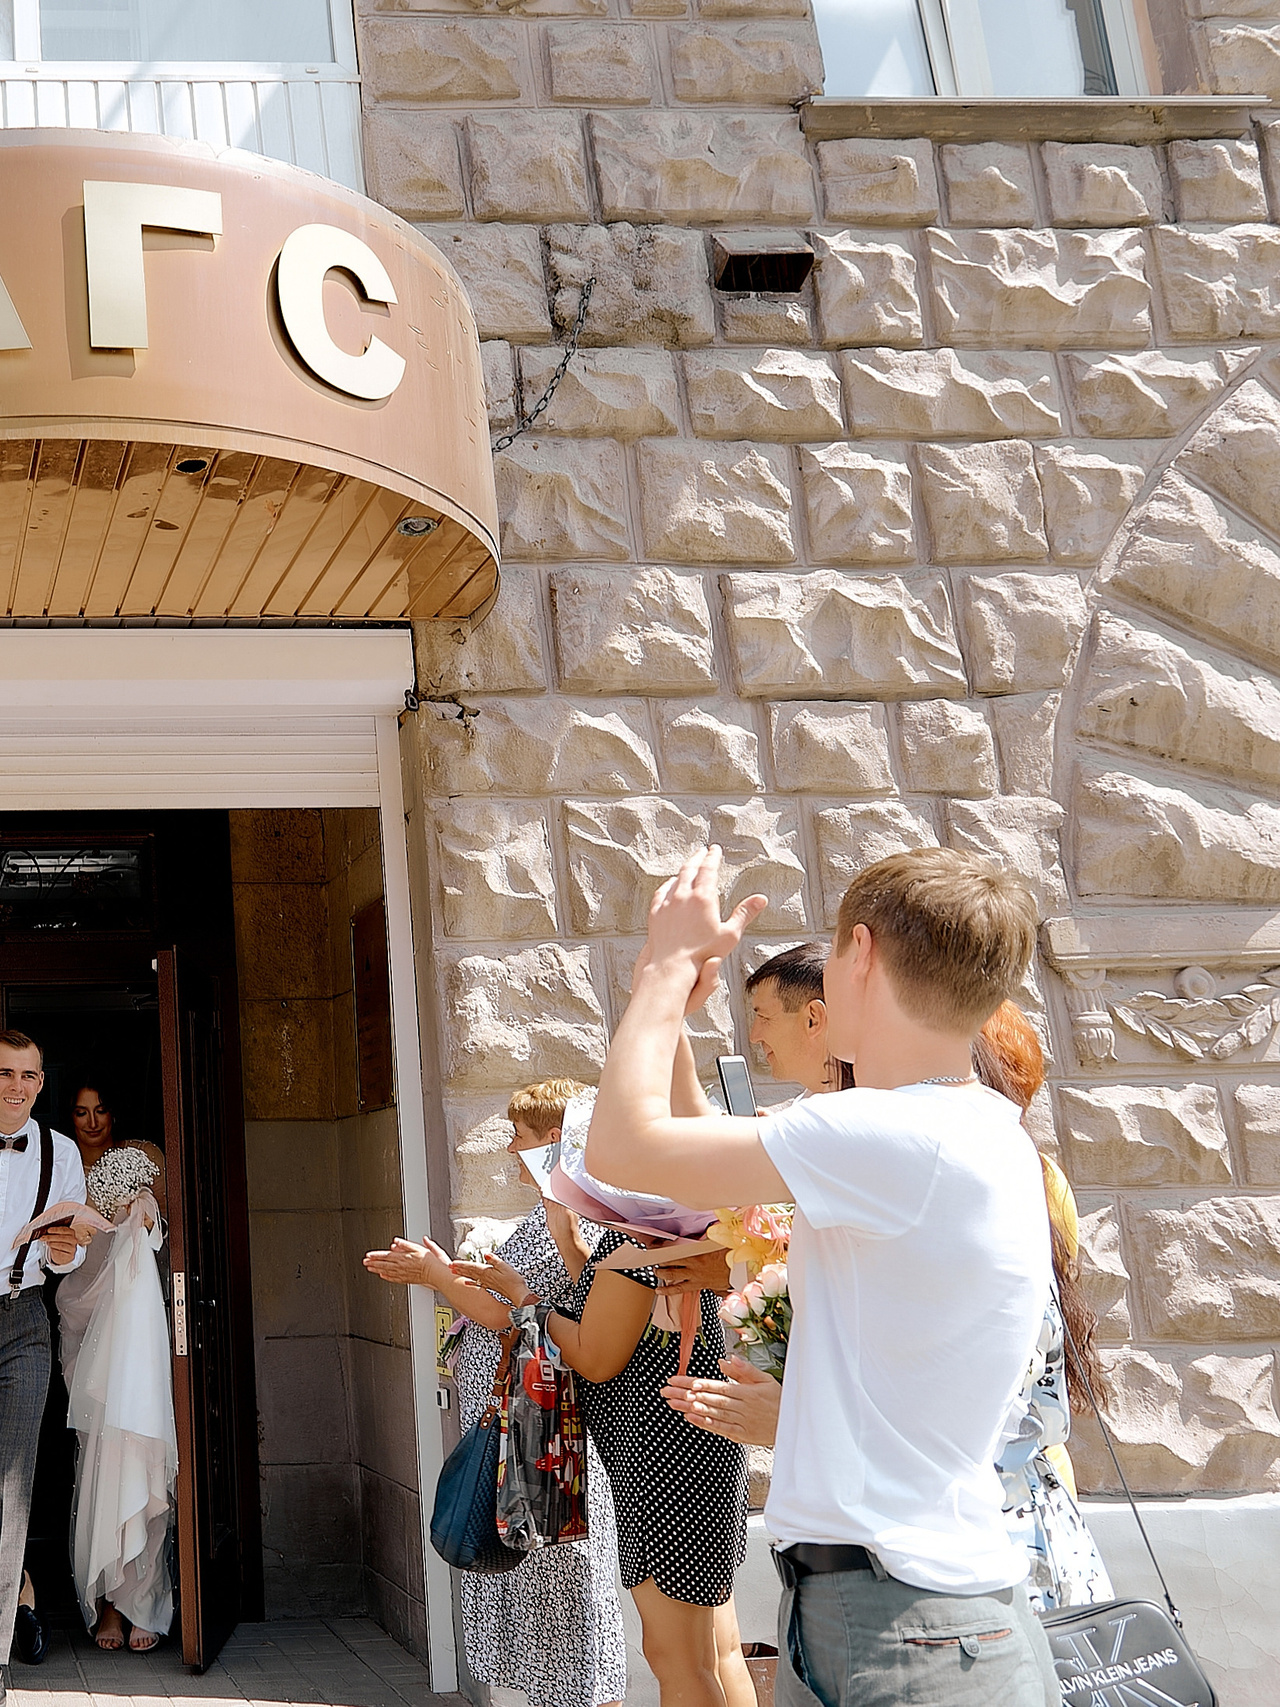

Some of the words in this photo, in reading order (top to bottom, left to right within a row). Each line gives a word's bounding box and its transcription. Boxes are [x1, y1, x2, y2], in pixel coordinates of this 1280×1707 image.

[1058, 1674, 1093, 1695] LVIN
[1090, 1663, 1133, 1685] KLEIN
[1132, 1647, 1178, 1675] JEANS
